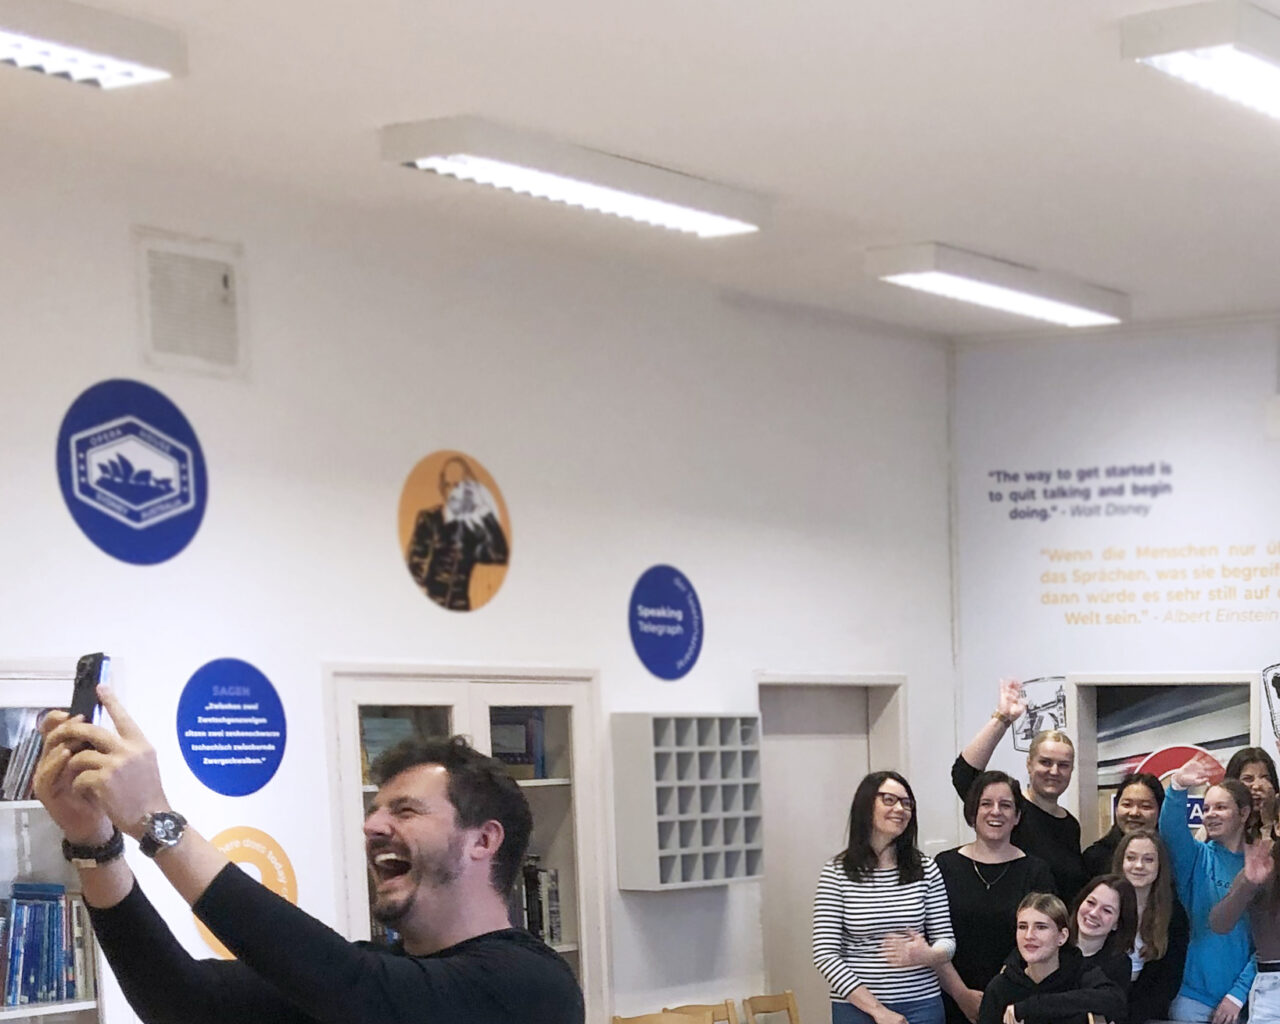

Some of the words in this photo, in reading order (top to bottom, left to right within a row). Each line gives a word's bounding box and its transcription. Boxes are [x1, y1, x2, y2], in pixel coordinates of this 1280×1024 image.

[1025, 471, 1051, 484] way
[1057, 469, 1071, 481] to
[1076, 467, 1099, 482] get
[1105, 464, 1154, 478] started
[1160, 463, 1172, 475] is
[989, 490, 1003, 502] to
[1009, 488, 1036, 503] quit
[1043, 485, 1091, 501] talking
[1098, 483, 1124, 498] and
[1131, 481, 1172, 499] begin
[1070, 503, 1101, 518] Walt
[1105, 501, 1150, 518] Disney
[1102, 545, 1126, 561] die
[1136, 544, 1219, 560] Menschen
[1229, 543, 1256, 556] nur
[1040, 568, 1067, 585] das
[1156, 568, 1187, 581] was
[1192, 565, 1216, 579] sie
[1040, 589, 1079, 605] dann
[1142, 590, 1160, 603] es
[1166, 586, 1200, 602] sehr
[1208, 585, 1237, 601] still
[1244, 584, 1270, 600] auf
[637, 604, 684, 622] Speaking
[1064, 610, 1100, 625] Welt
[1162, 608, 1211, 624] Albert
[1215, 608, 1280, 623] Einstein
[637, 619, 685, 637] Telegraph
